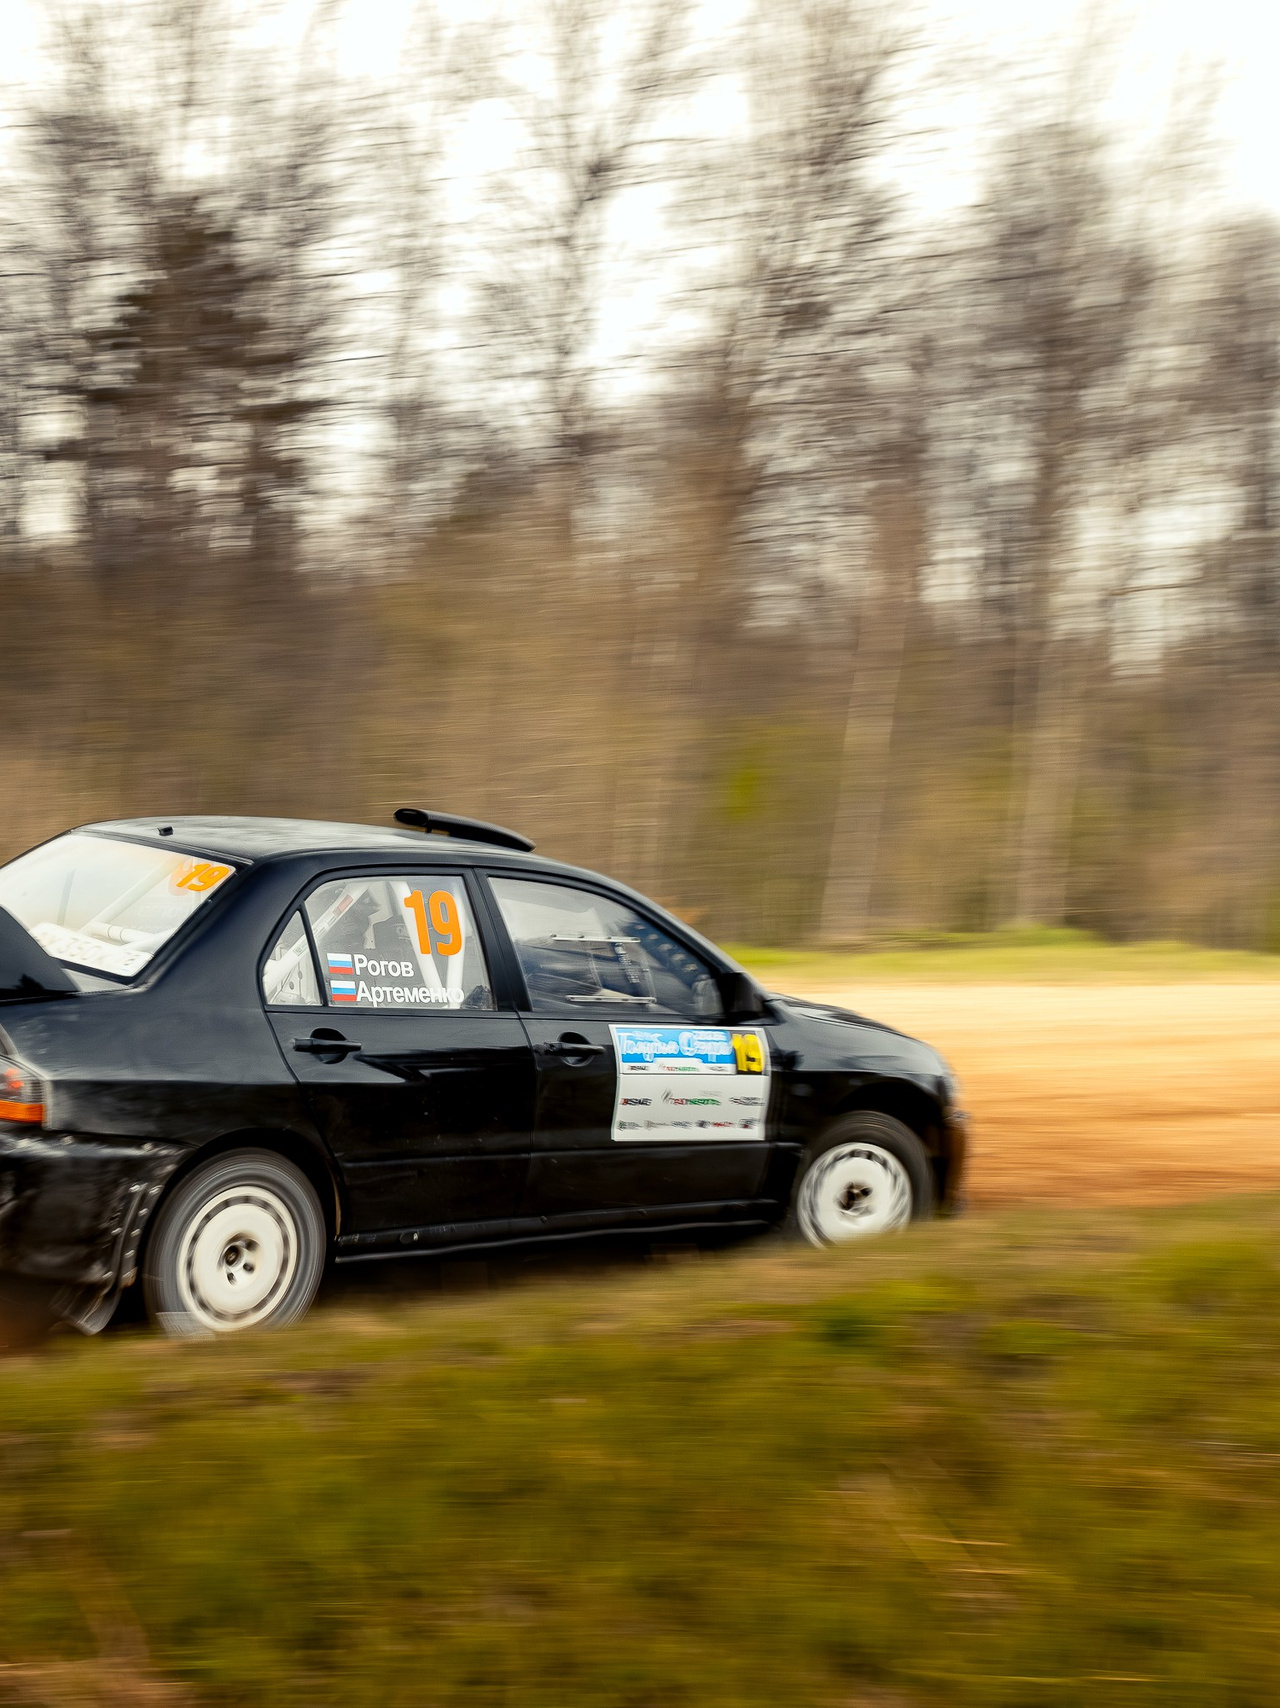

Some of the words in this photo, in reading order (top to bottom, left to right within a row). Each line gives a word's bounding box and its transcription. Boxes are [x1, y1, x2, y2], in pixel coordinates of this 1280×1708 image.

[176, 863, 230, 891] 19
[404, 890, 462, 956] 19
[354, 954, 414, 977] Рогов
[356, 981, 465, 1007] Артеменко
